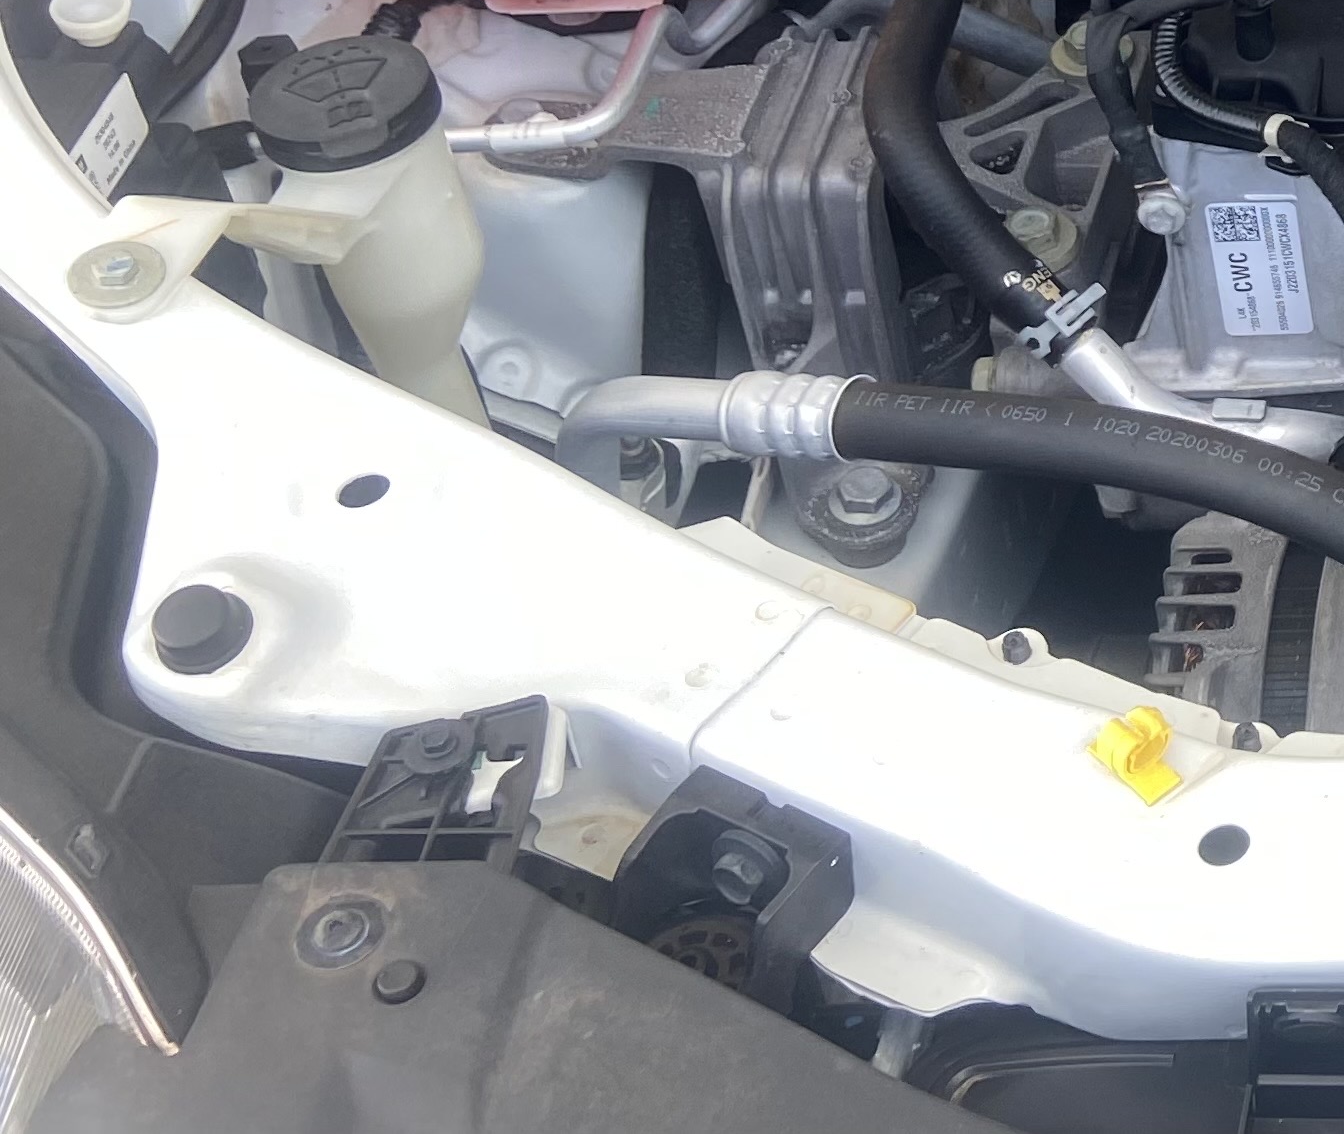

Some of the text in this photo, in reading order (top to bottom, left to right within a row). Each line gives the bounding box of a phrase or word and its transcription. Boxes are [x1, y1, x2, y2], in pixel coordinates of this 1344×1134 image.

[1228, 252, 1254, 293] CWC
[894, 394, 932, 411] PET
[1001, 404, 1047, 423] 0650
[1093, 416, 1140, 437] 1020
[1145, 426, 1248, 464] 20200306
[1257, 458, 1325, 493] 00:25
